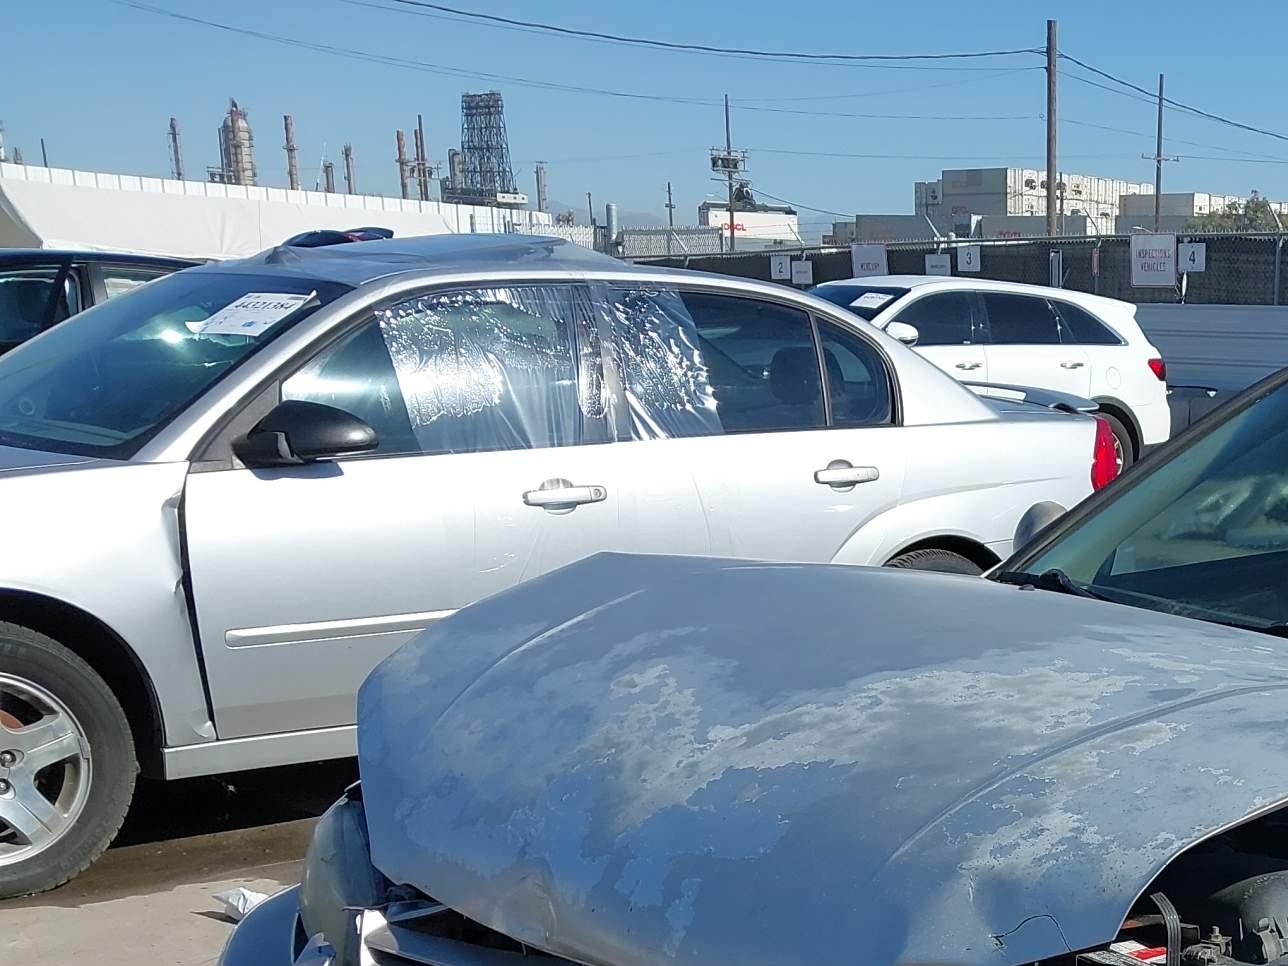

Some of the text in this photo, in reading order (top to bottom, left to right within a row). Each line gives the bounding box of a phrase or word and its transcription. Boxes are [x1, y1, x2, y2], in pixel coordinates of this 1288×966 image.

[966, 252, 973, 265] 3
[1135, 249, 1171, 259] INSPECTIONS
[1188, 250, 1196, 265] 4
[777, 262, 784, 273] 2
[1140, 262, 1166, 272] VEHICLES
